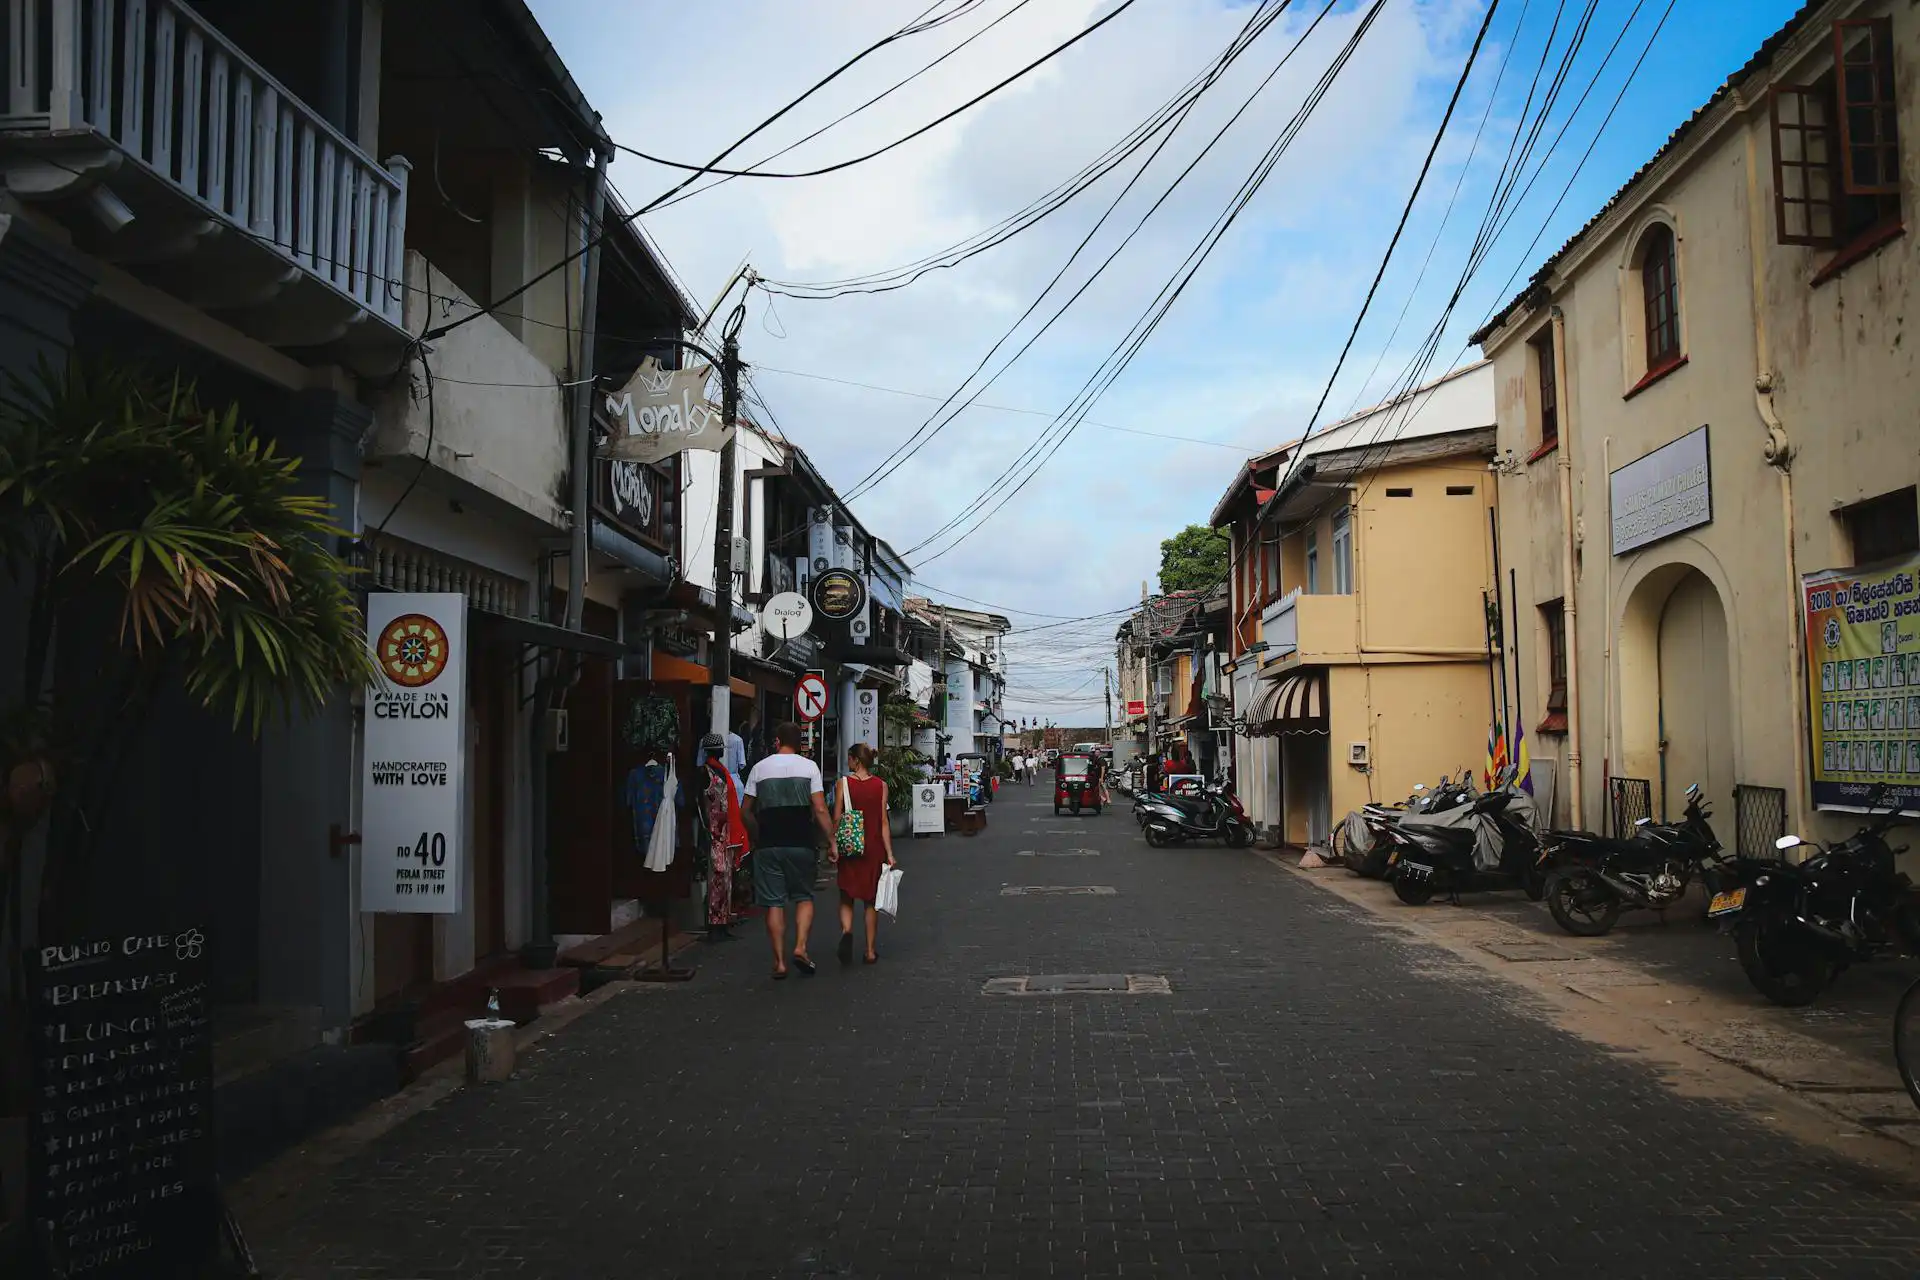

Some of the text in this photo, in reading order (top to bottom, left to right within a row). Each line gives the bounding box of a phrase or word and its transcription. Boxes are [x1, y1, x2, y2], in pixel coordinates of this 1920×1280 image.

[605, 387, 711, 439] Monaky
[1809, 590, 1831, 611] 2018
[774, 608, 802, 617] Dialog
[385, 692, 438, 701] MADE IN
[374, 702, 448, 719] CEYLON
[372, 761, 447, 772] HANDCRAFTED
[372, 773, 447, 786] WITH LOVE
[397, 832, 446, 866] no 40
[396, 869, 445, 880] PEDLAR STREET
[396, 883, 413, 894] 0775
[52, 971, 178, 1006] BREAKFAST
[58, 1014, 157, 1044] LUNCH
